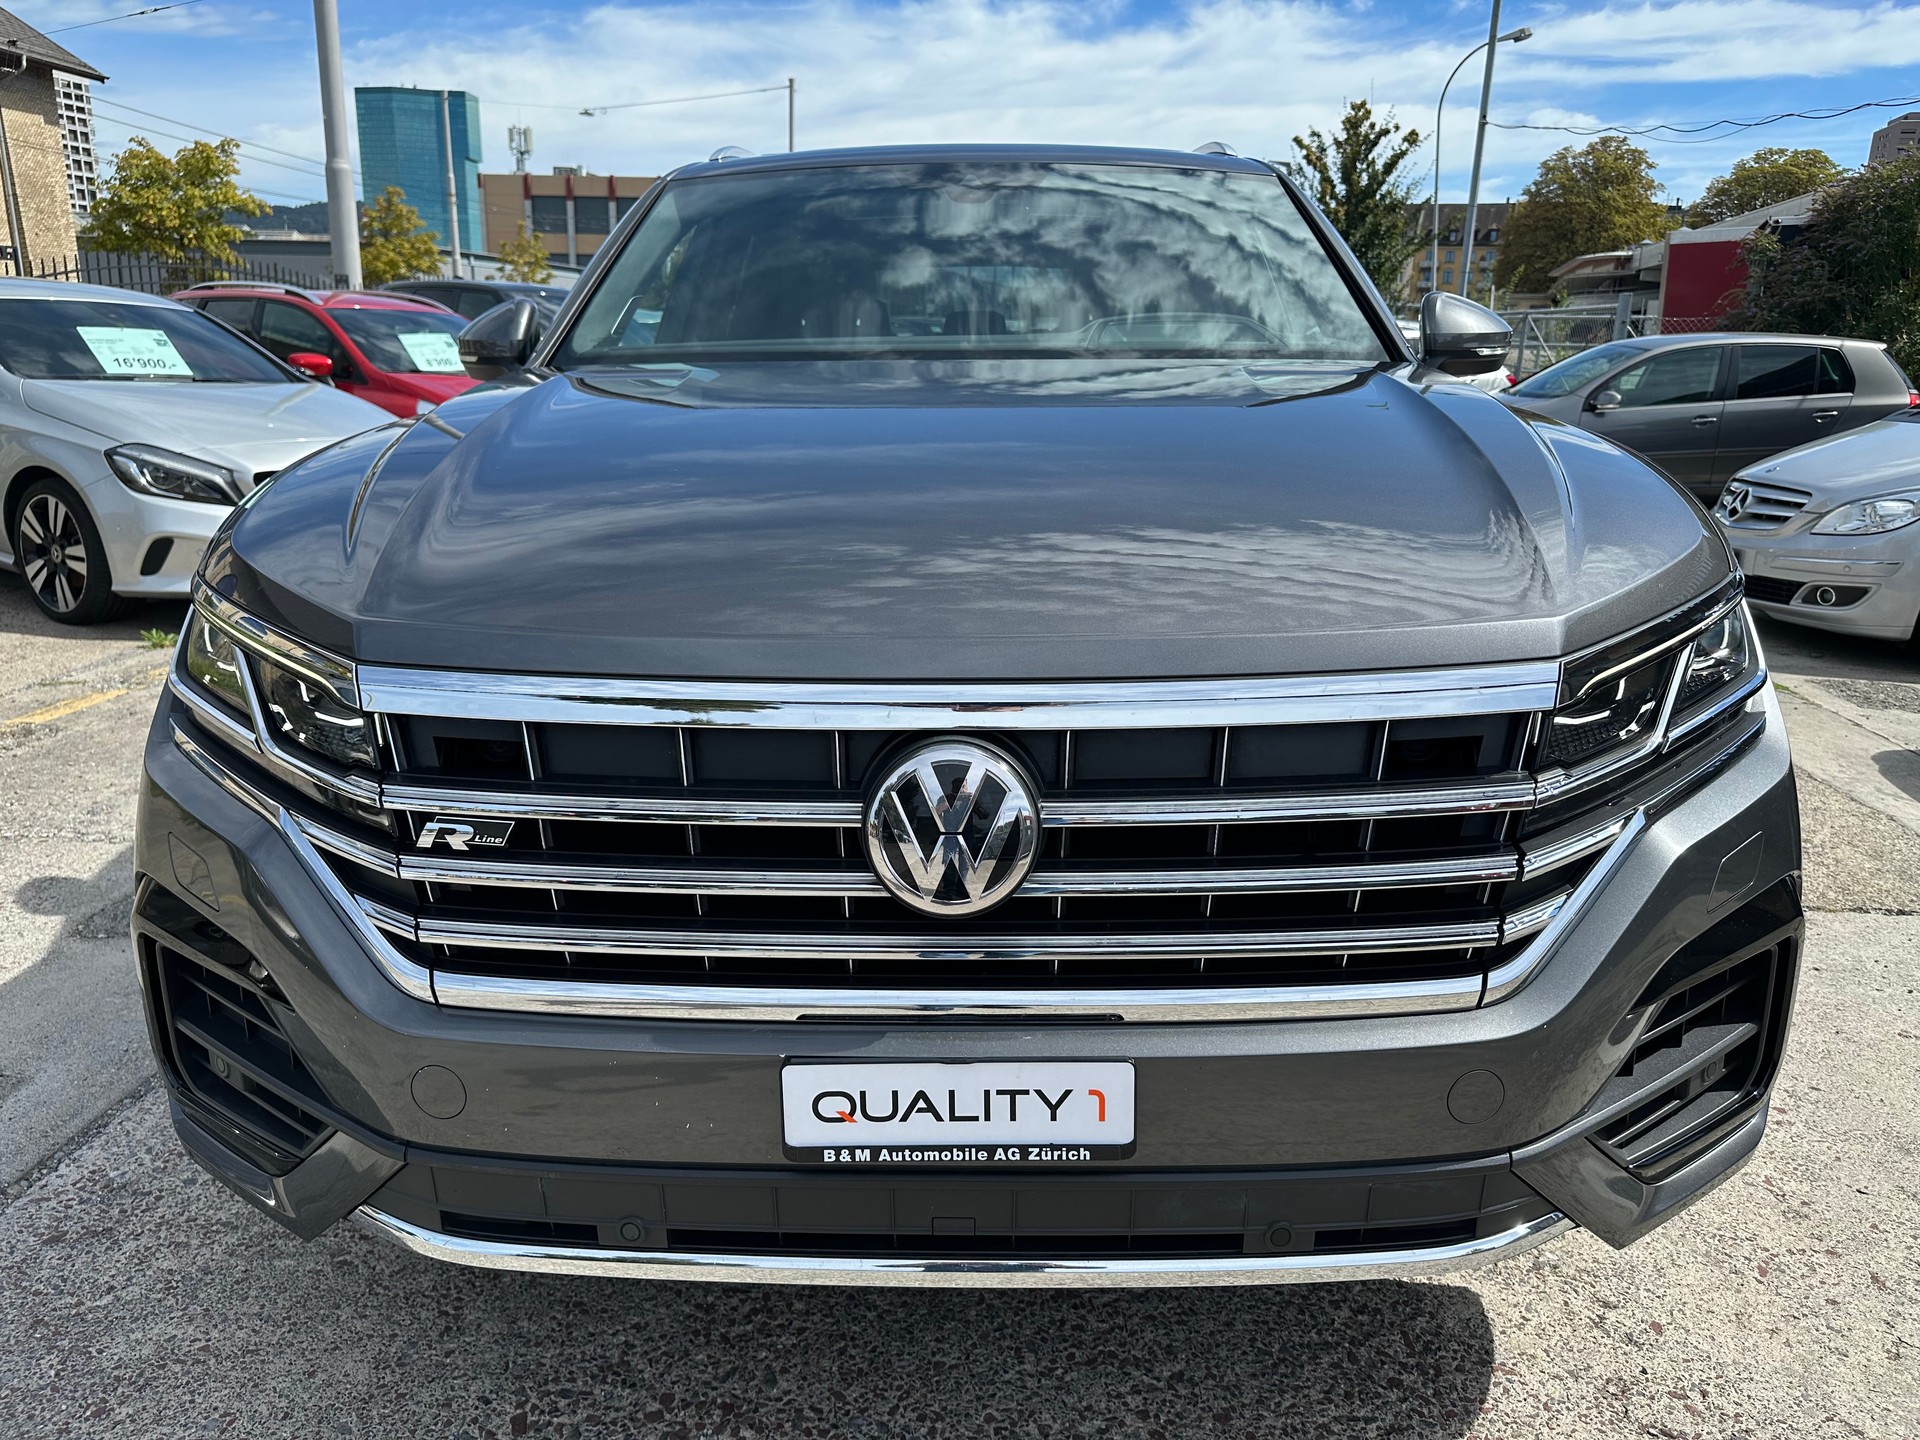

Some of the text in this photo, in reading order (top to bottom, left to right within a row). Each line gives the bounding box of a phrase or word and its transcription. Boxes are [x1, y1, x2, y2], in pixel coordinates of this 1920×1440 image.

[416, 822, 503, 851] R Line
[811, 1089, 1106, 1123] QUALITY 1
[878, 1148, 988, 1162] Automobile
[994, 1148, 1021, 1162] AG
[1028, 1147, 1091, 1161] Zürich
